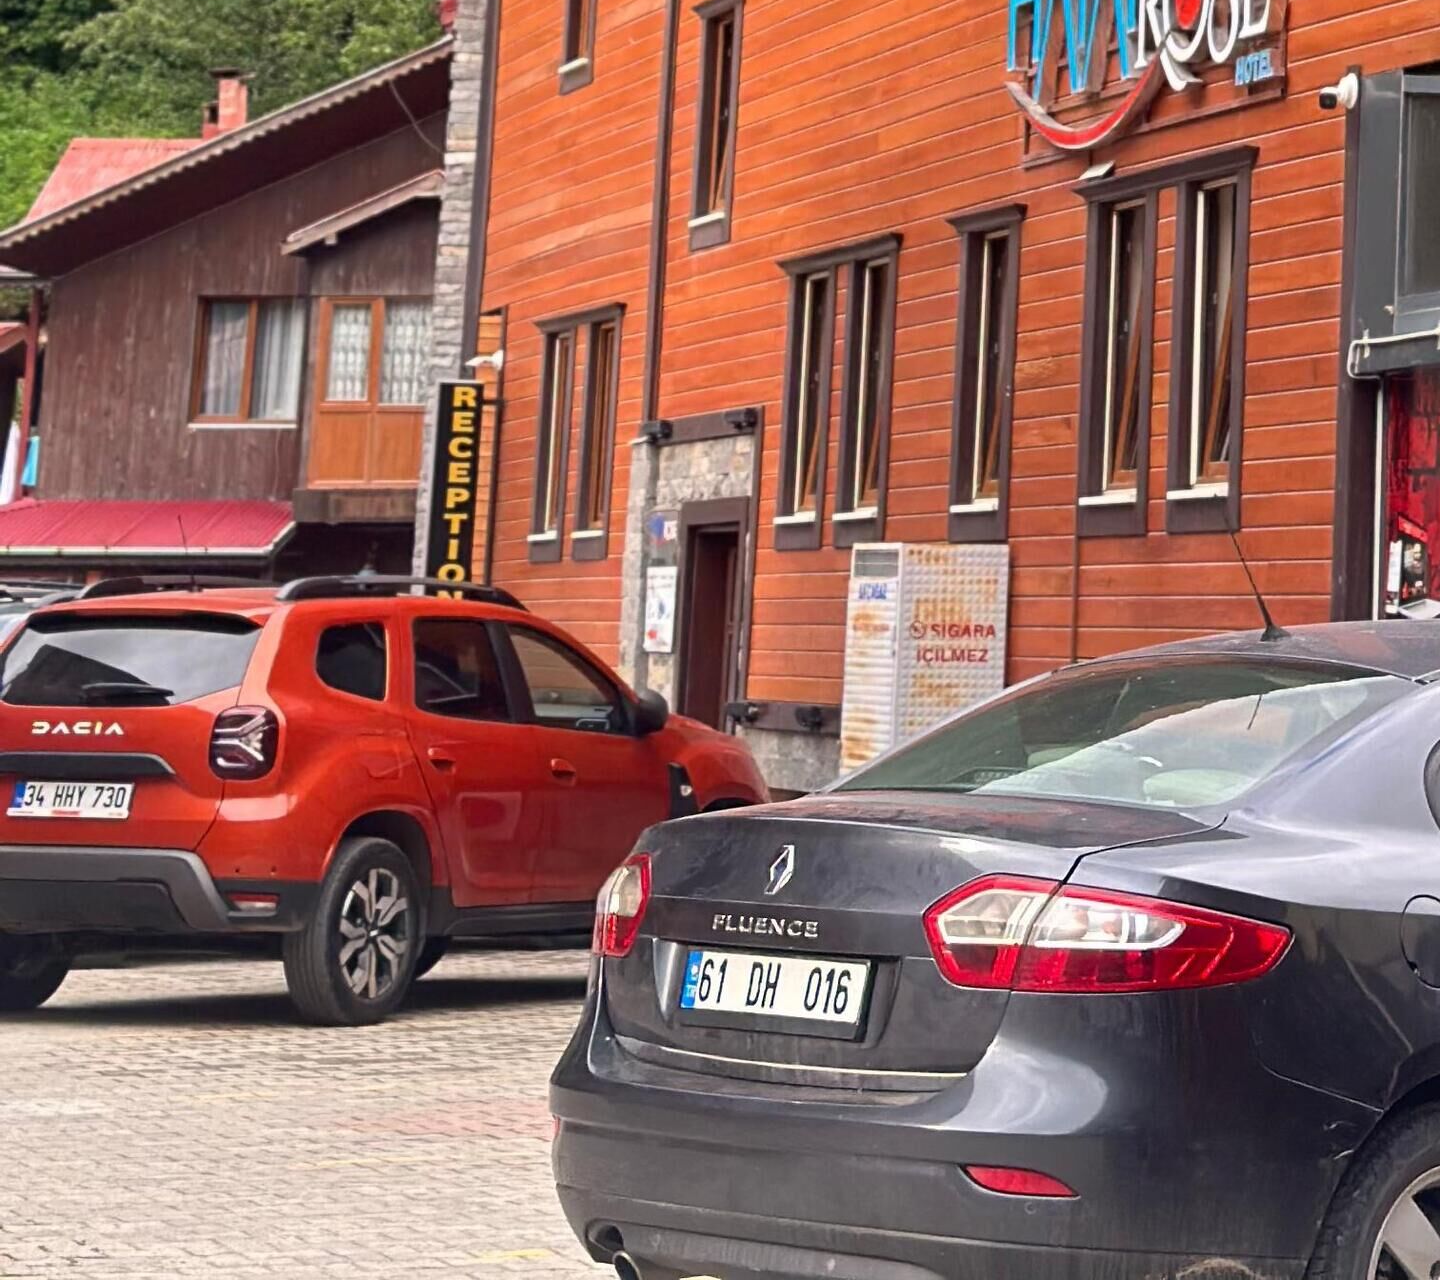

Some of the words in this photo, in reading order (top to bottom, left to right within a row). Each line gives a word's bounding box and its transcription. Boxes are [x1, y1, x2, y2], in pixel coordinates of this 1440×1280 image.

[31, 720, 124, 735] DACIA
[24, 784, 45, 807] 34
[52, 784, 87, 807] HHY
[92, 785, 127, 808] 730
[711, 913, 819, 938] FLUENCE
[699, 958, 728, 1004] 61
[745, 961, 782, 1009] DH
[804, 966, 852, 1015] 016
